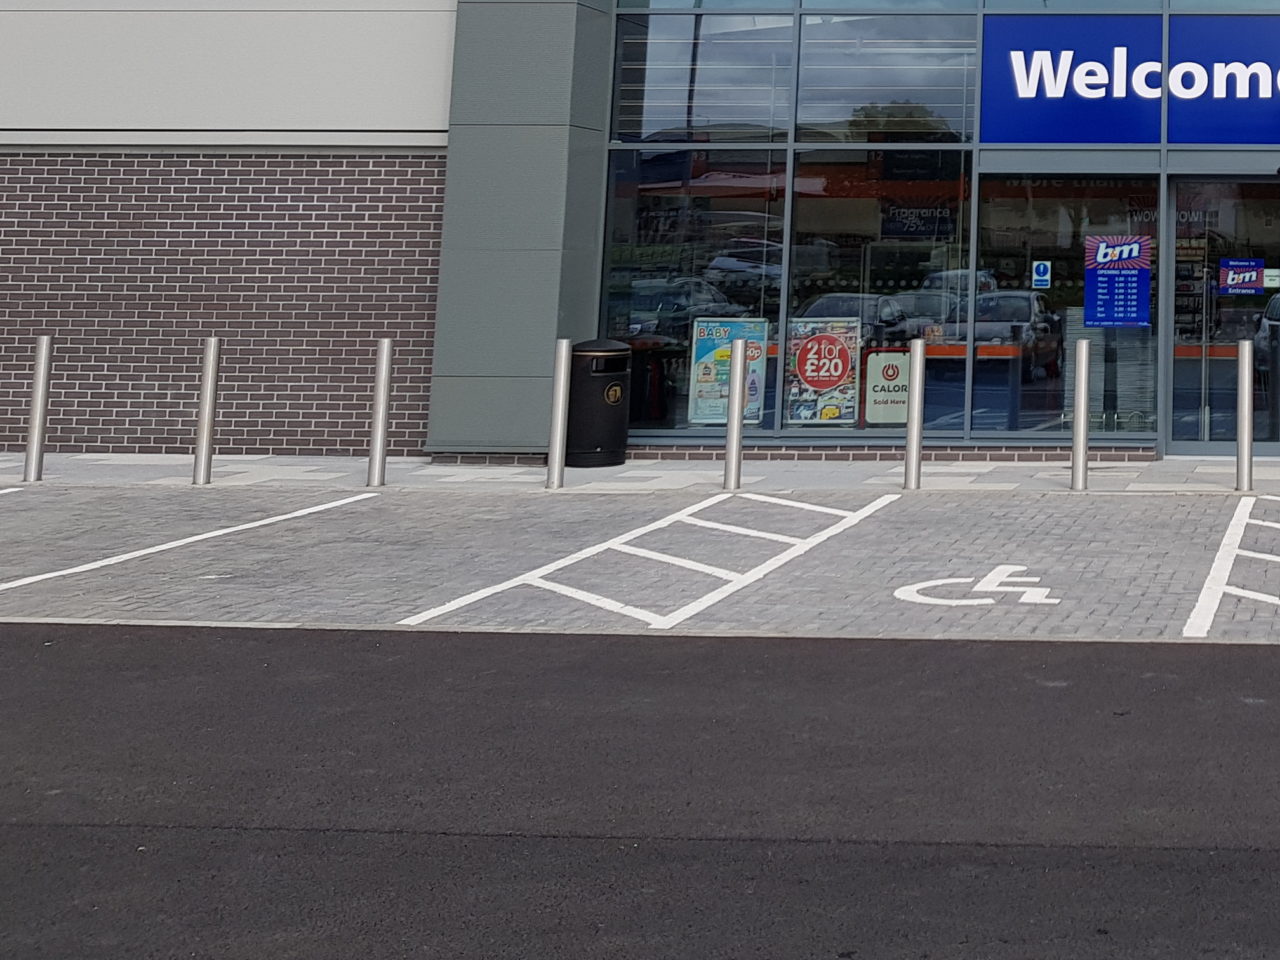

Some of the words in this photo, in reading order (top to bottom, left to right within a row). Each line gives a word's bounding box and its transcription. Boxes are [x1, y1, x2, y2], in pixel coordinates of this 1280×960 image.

[889, 206, 951, 220] Fragrance
[1096, 241, 1140, 263] b&m
[698, 327, 730, 339] BABY
[806, 341, 819, 358] 2
[820, 340, 843, 358] for
[805, 358, 843, 376] £20
[872, 385, 908, 393] CALOR
